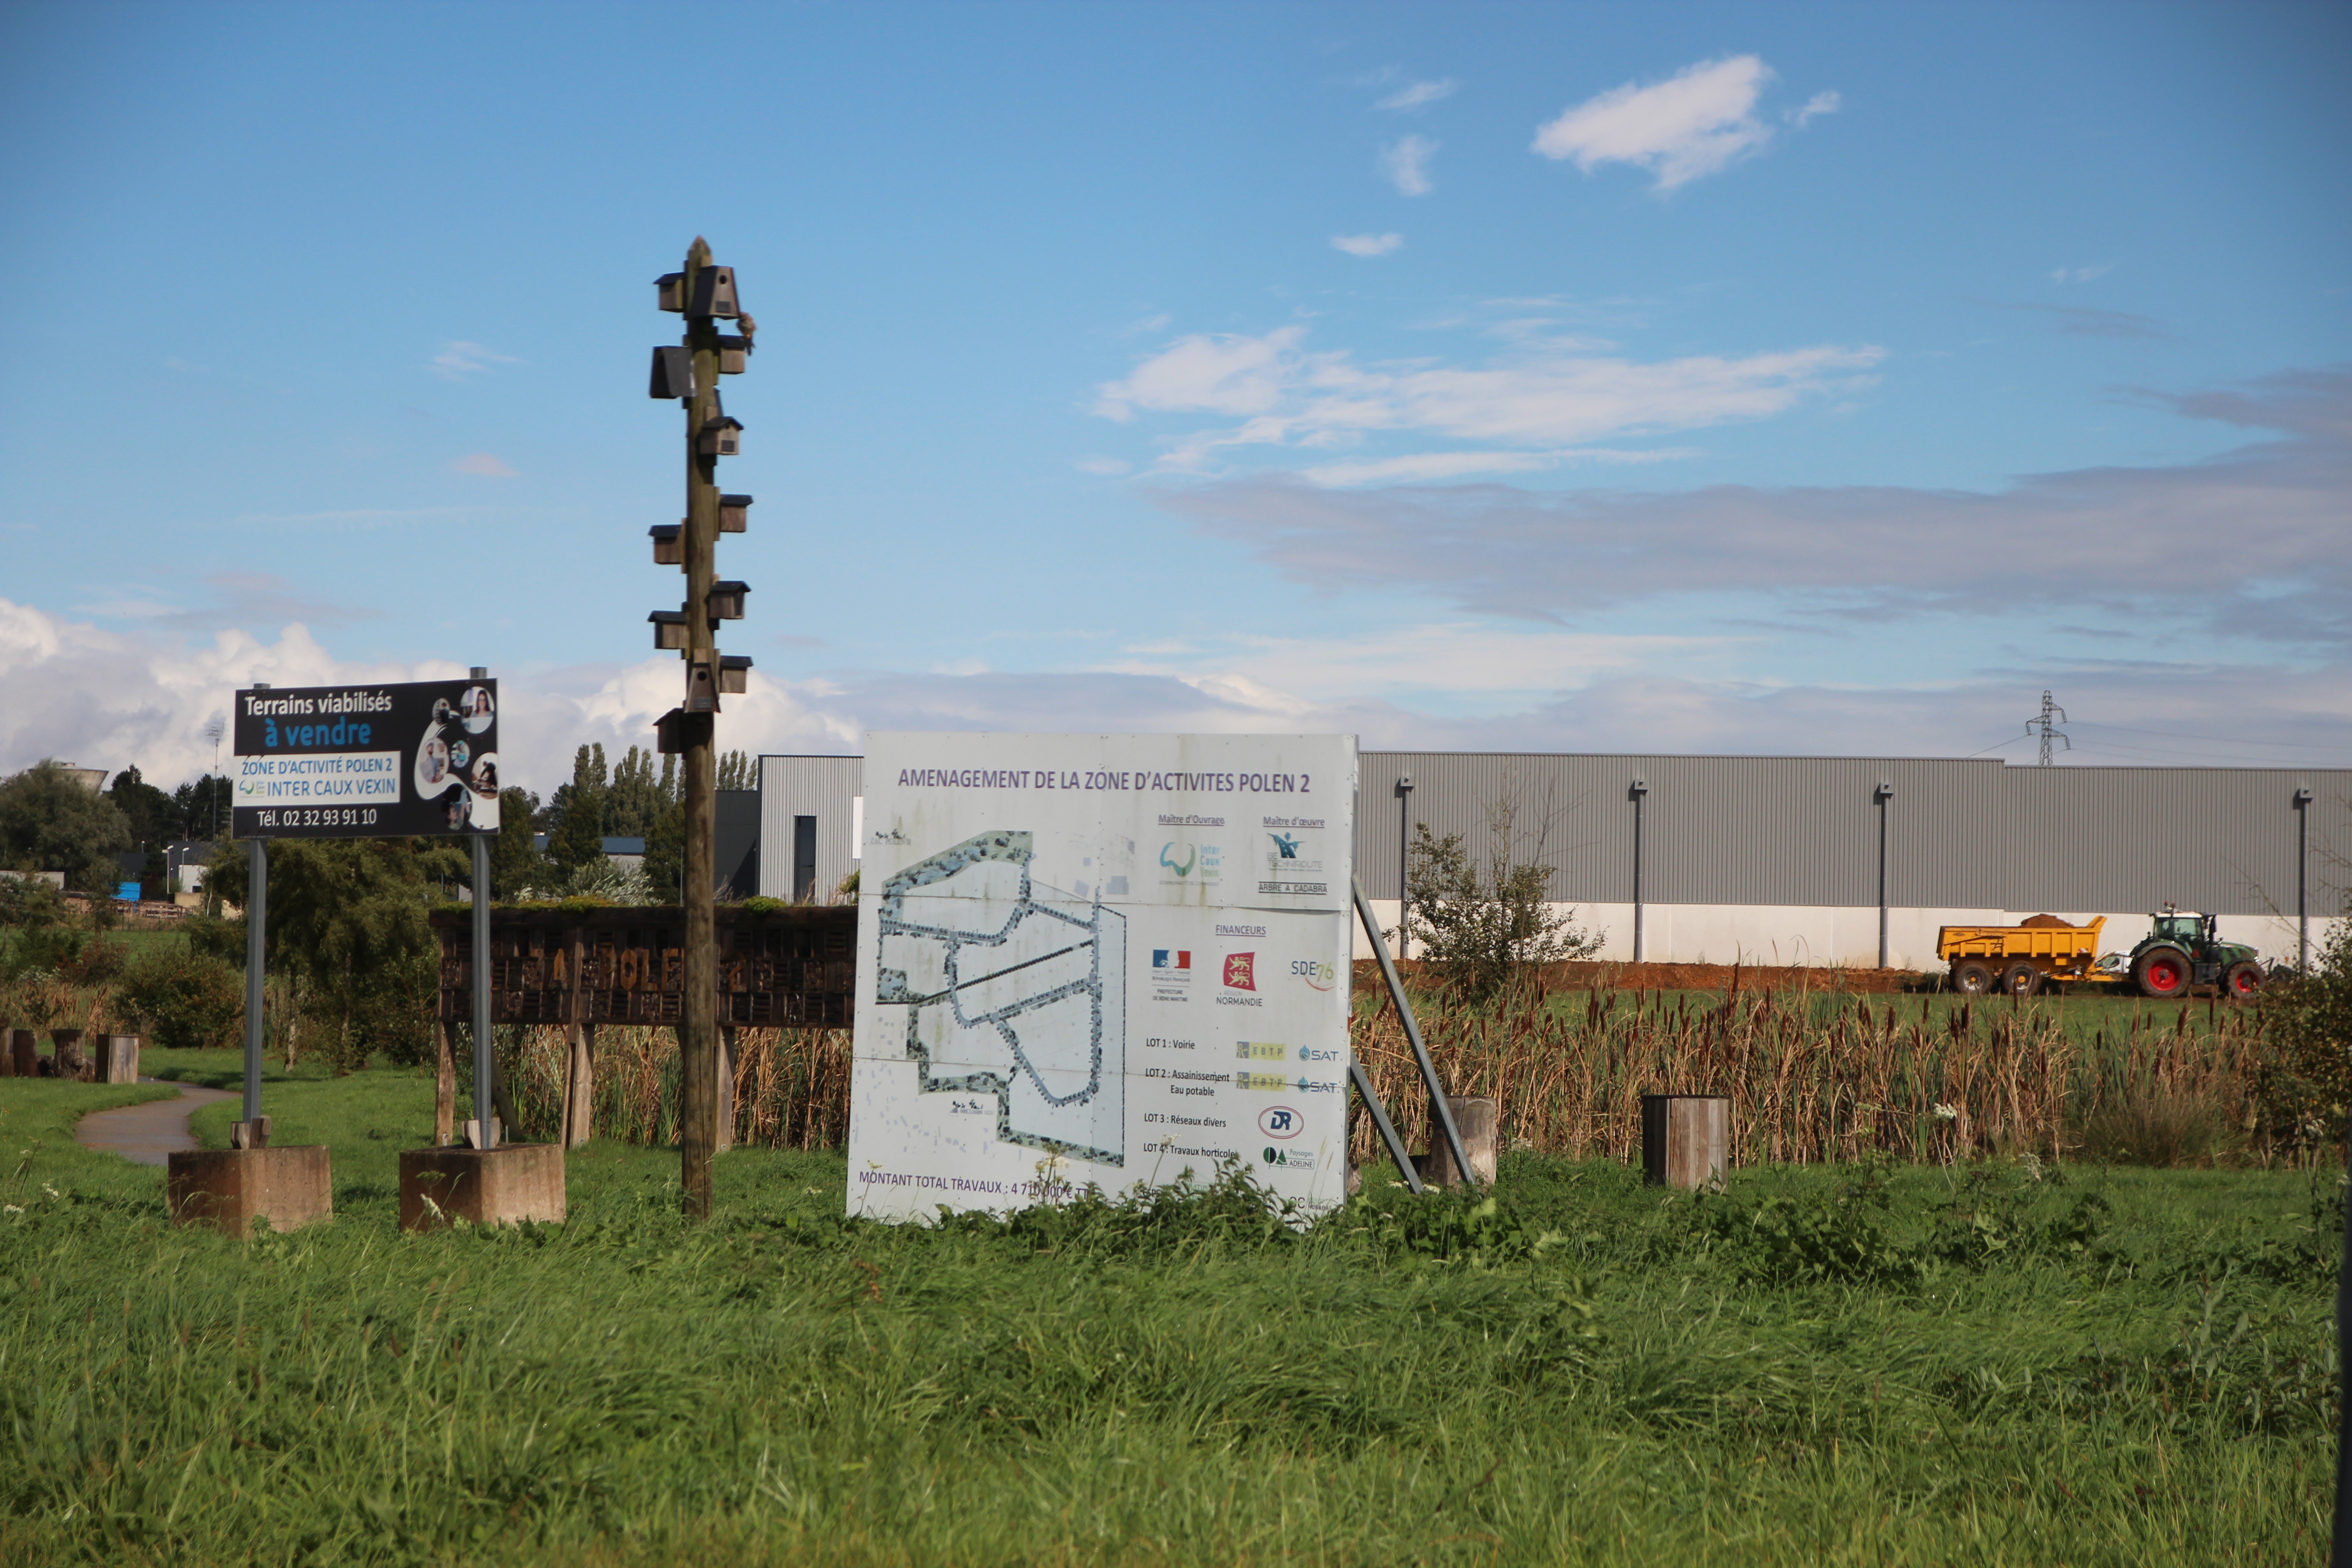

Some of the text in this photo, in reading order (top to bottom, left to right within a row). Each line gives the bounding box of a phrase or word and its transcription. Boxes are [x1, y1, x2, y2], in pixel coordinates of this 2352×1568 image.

[245, 690, 392, 715] Terrains viabilisés
[265, 716, 371, 747] à vendre
[242, 756, 392, 775] ZONE D'ACTIVITÉ POLEN 2
[898, 768, 1310, 792] AMENAGEMENT DE LA ZONE D'ACTIVITES POLEN 2
[268, 778, 396, 796] INTER CAUX VEXIN
[257, 808, 377, 827] Tél. 02 32 93 91 10
[1159, 814, 1225, 825] Maître d'Ouvrage
[1263, 816, 1290, 825] Maître
[1200, 844, 1220, 854] Inter
[1200, 855, 1220, 866] Caux
[1258, 883, 1282, 891] ARBRE
[1294, 885, 1328, 893] CADABRA
[1215, 925, 1266, 935] FINANCEURS
[1216, 996, 1263, 1007] NORMANDIE
[1146, 1038, 1161, 1047] LOT
[1162, 1039, 1166, 1048] 1
[1173, 1039, 1196, 1049] Voirie
[1253, 1047, 1283, 1056] EBTP
[1311, 1050, 1339, 1061] SAT
[1146, 1068, 1160, 1077] LOT
[1161, 1069, 1166, 1078] 2
[1172, 1070, 1230, 1082] Assainissement
[1171, 1085, 1215, 1097] Eau potable
[1310, 1082, 1338, 1093] SAT
[1144, 1113, 1158, 1122] LOT
[1160, 1114, 1165, 1123] 3
[1171, 1115, 1202, 1126] Réseaux
[1204, 1117, 1226, 1127] divers
[1144, 1143, 1157, 1152] LOT
[1159, 1144, 1164, 1153] 4
[1170, 1145, 1200, 1156] Travaux
[1290, 1149, 1313, 1158] Paysages
[1289, 1160, 1313, 1168] ADELINE
[859, 1171, 913, 1186] MONTANT
[915, 1176, 948, 1190] TOTAL
[951, 1178, 1002, 1194] TRAVAUX
[1011, 1183, 1018, 1195] 4
[1066, 1189, 1073, 1199] €
